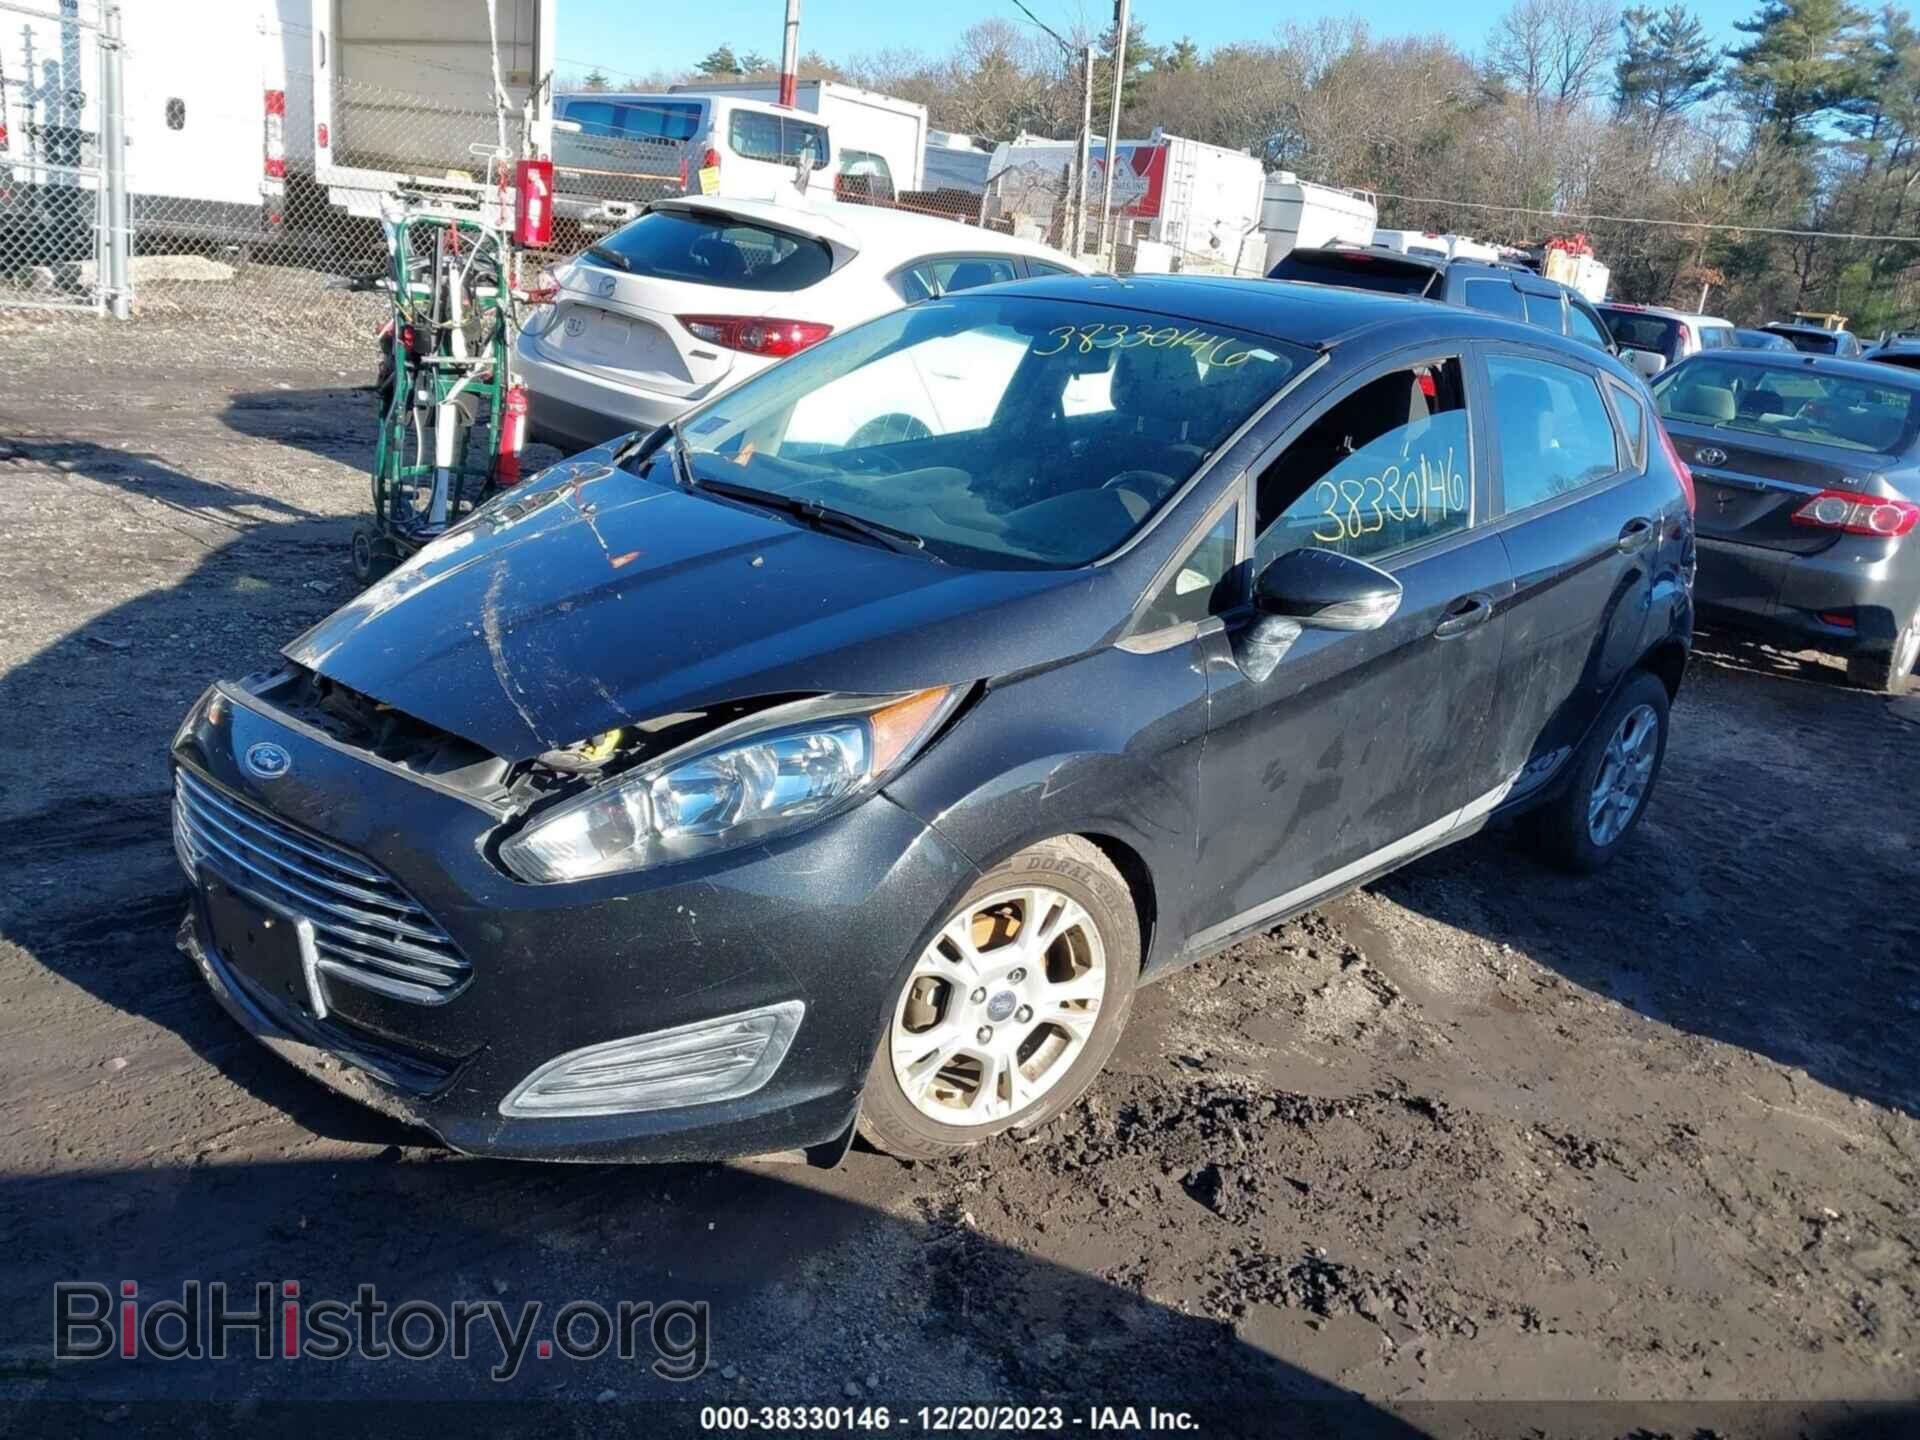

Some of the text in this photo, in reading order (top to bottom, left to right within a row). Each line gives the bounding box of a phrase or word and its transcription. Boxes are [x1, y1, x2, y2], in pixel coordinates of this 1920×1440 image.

[1033, 323, 1250, 367] 38330146
[1312, 446, 1465, 542] 38330146
[1025, 856, 1092, 884] DORAL
